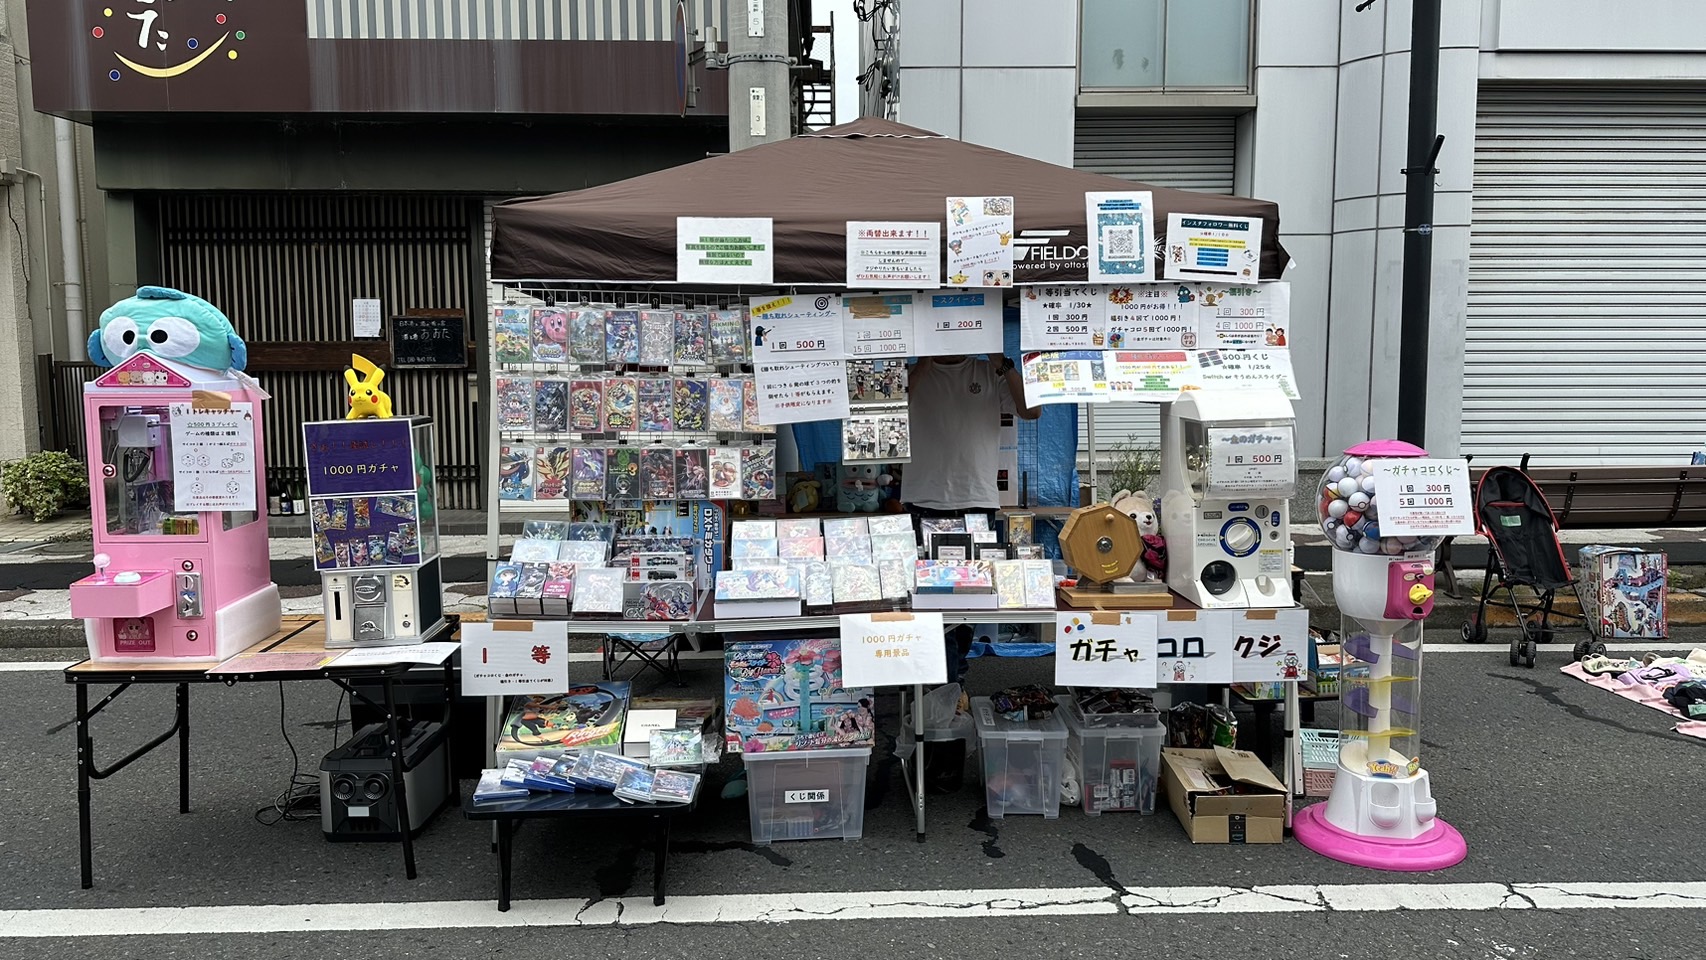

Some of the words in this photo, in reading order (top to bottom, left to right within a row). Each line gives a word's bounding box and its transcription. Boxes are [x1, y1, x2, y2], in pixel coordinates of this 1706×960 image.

[126, 0, 169, 51] た
[1049, 261, 1061, 270] by
[1239, 307, 1265, 315] 300円
[957, 320, 982, 328] 200円
[1234, 321, 1265, 329] 1000円
[878, 329, 901, 338] 100円
[771, 341, 787, 350] 1回
[796, 339, 825, 348] 500円
[879, 343, 907, 352] 1000円
[1252, 454, 1282, 463] 500円
[323, 462, 399, 475] 1000円ガチャ
[1426, 484, 1451, 492] 300円
[1399, 497, 1415, 506] 5回
[1424, 497, 1453, 506] 1000円
[862, 633, 922, 644] 1000円ガチャ
[1070, 638, 1139, 662] ガチャ
[1233, 634, 1281, 659] クジ
[531, 644, 551, 664] 等
[875, 648, 910, 658] 専用景品
[790, 791, 825, 800] くじ関係
